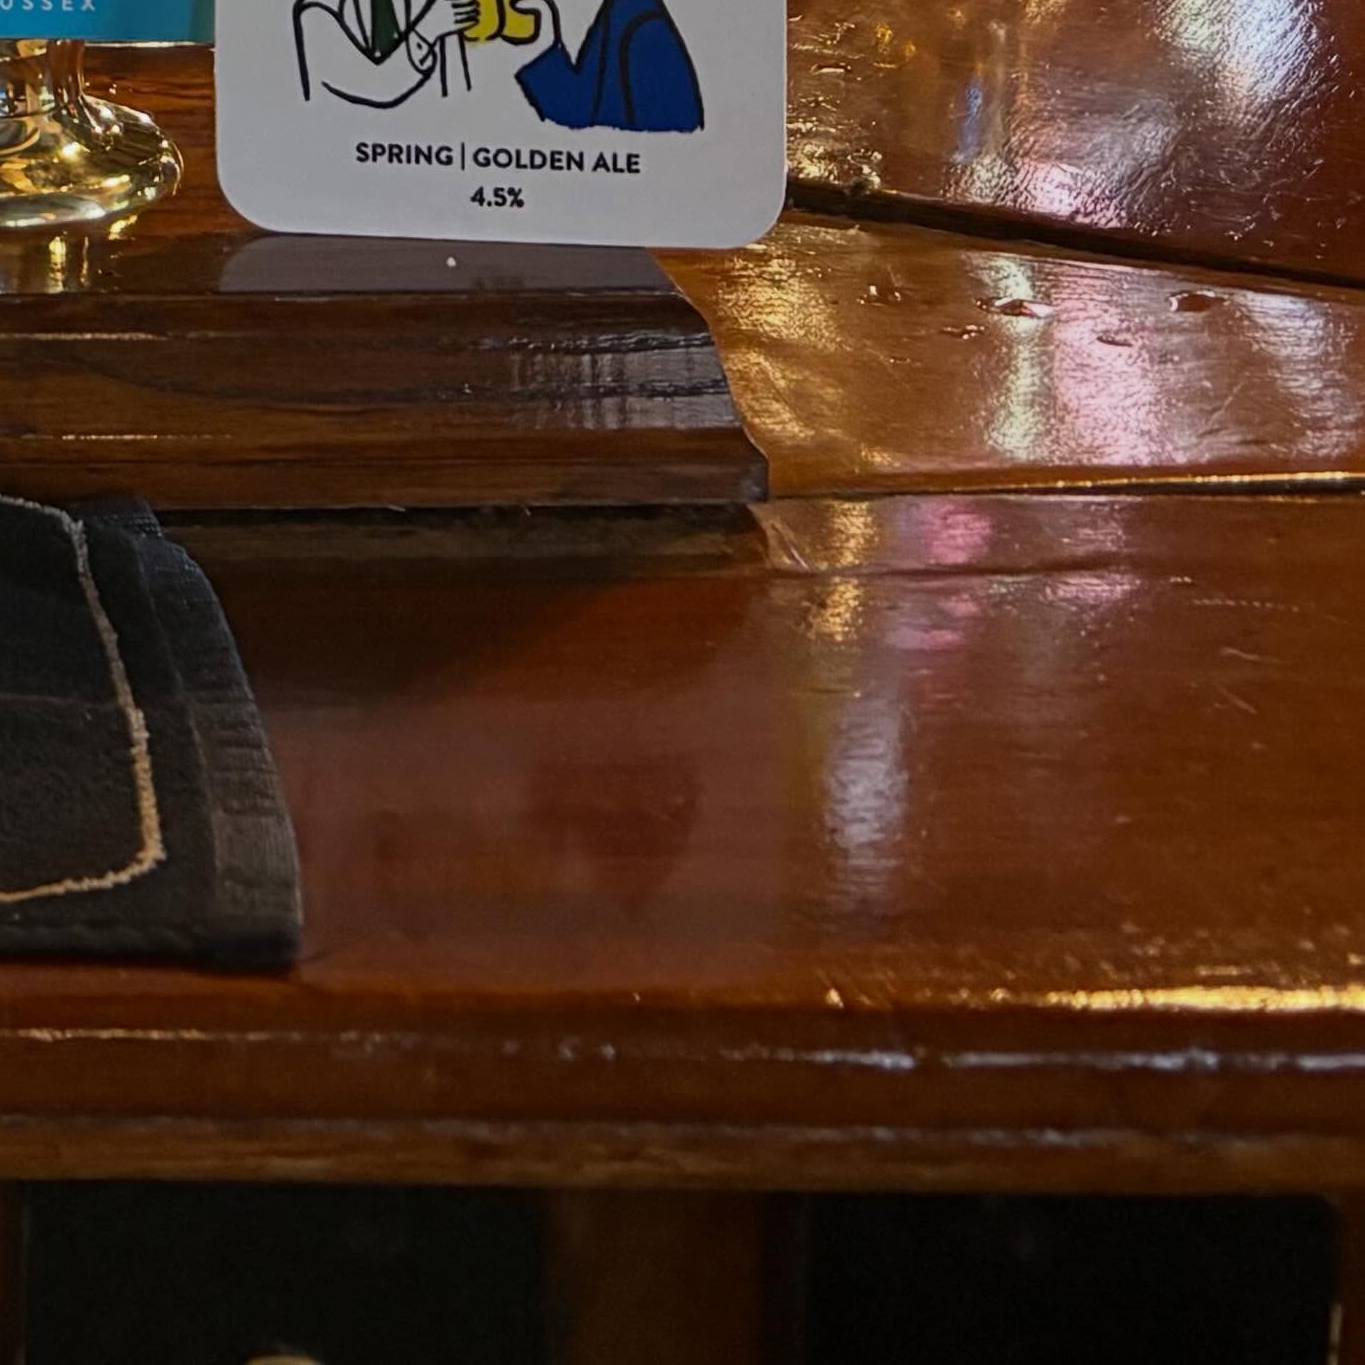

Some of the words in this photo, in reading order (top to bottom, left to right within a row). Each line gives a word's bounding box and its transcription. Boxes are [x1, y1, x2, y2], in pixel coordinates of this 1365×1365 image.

[355, 141, 455, 168] SPRING
[472, 146, 587, 172] GOLDEN
[591, 151, 642, 175] ALE
[470, 186, 526, 209] 4.5%
